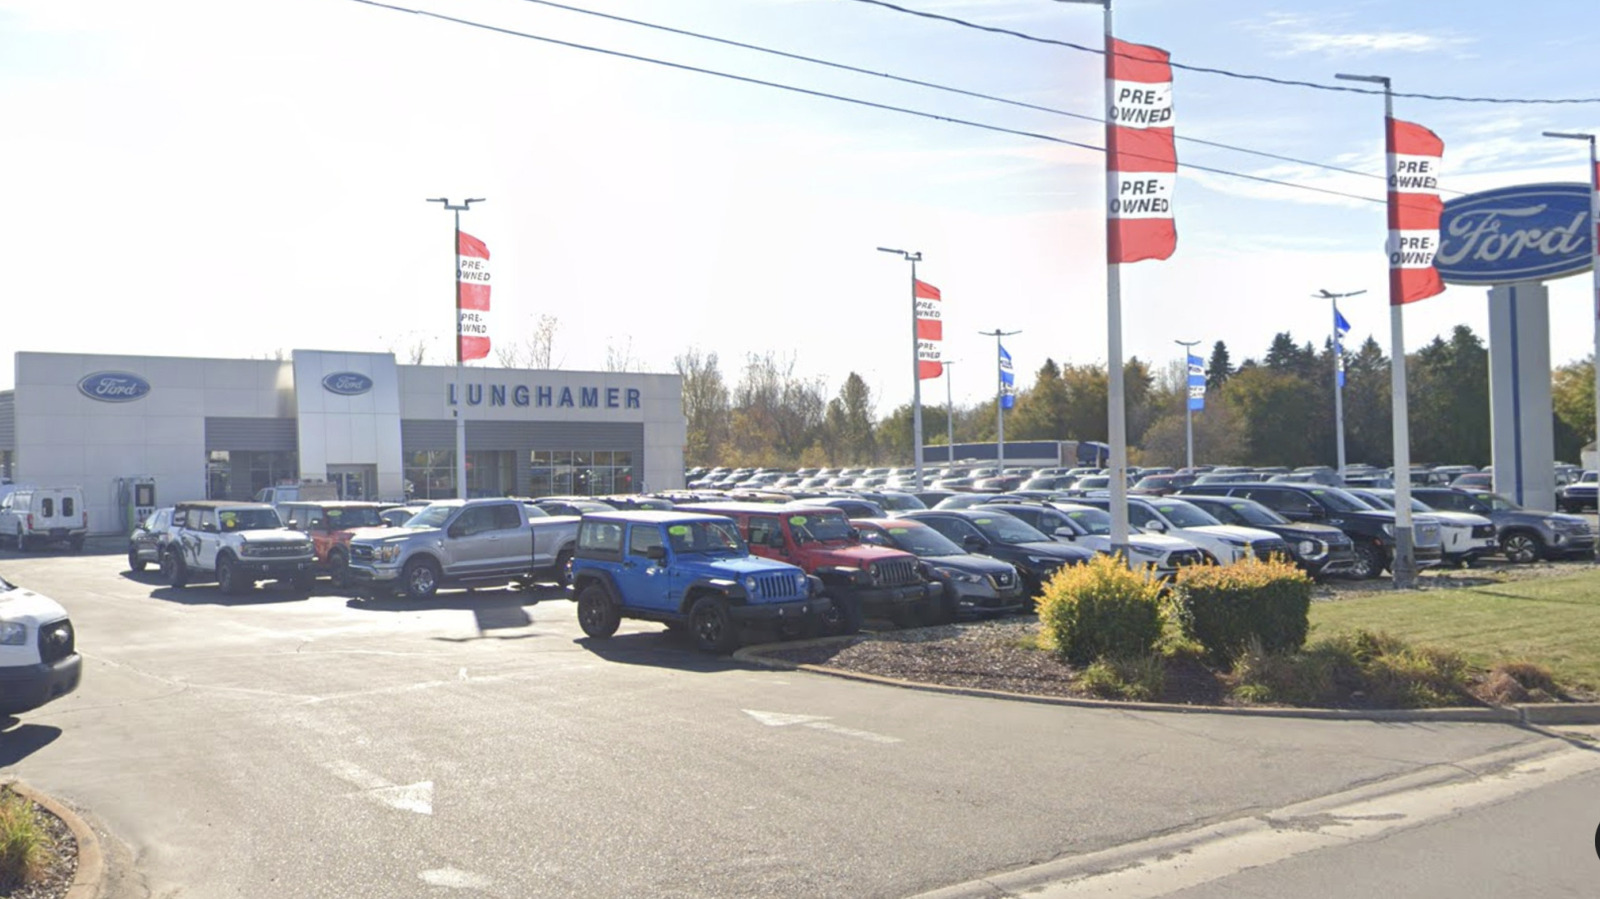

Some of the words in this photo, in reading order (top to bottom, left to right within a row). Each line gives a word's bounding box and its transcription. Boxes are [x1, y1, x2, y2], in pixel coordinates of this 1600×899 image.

[1119, 88, 1163, 105] PRE-
[1109, 106, 1171, 123] OWNED
[1397, 161, 1433, 173] PRE-
[1120, 180, 1164, 195] PRE-
[1110, 198, 1169, 214] OWNED
[1436, 204, 1588, 265] Ford
[1400, 237, 1434, 249] PRE-
[461, 260, 484, 269] PRE-
[456, 269, 491, 281] OWNED
[461, 313, 482, 322] PRE-
[96, 377, 137, 395] Ford
[336, 375, 363, 389] Ford
[448, 383, 640, 408] LUNGHAMER
